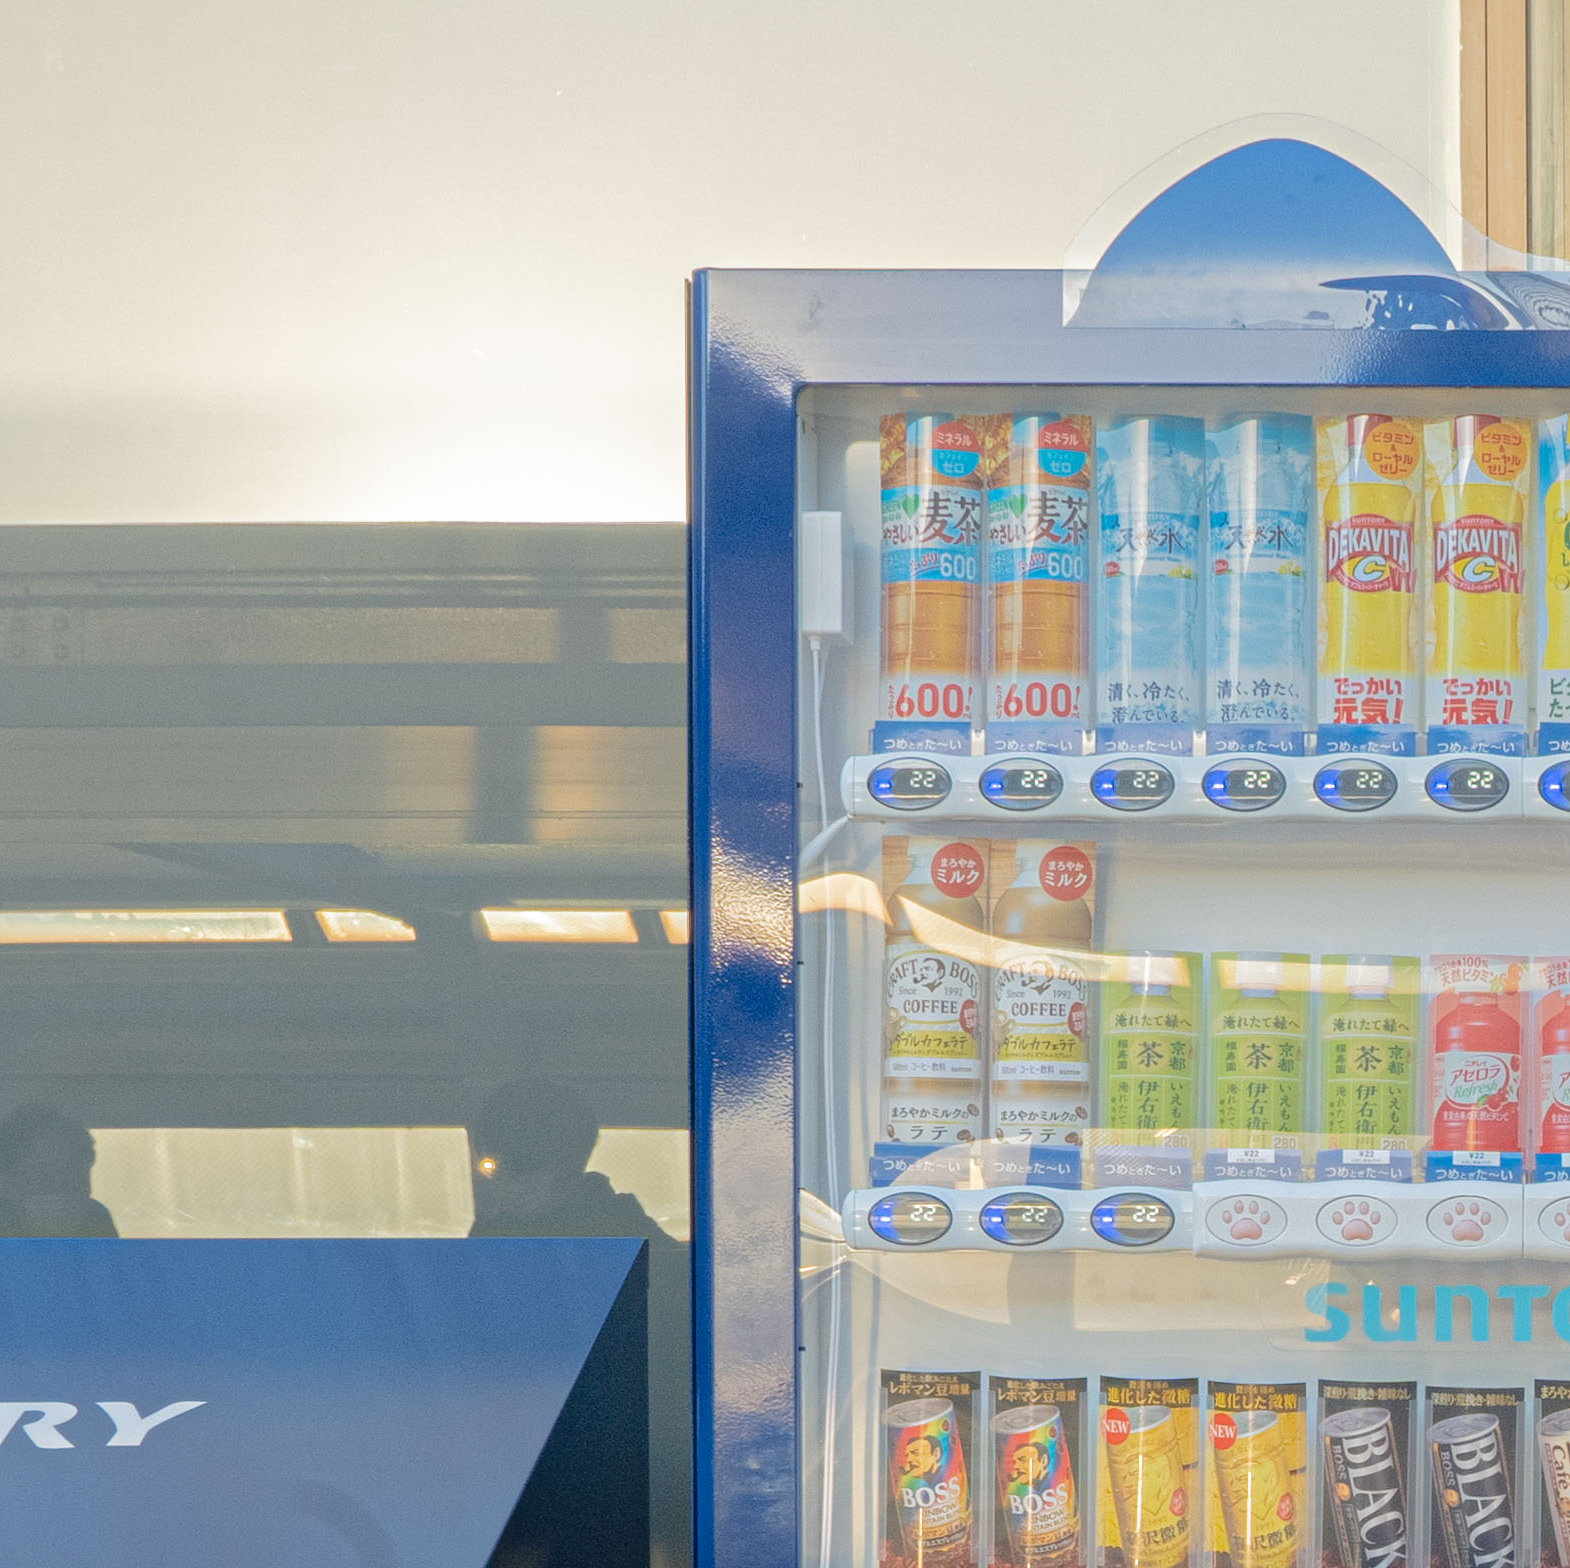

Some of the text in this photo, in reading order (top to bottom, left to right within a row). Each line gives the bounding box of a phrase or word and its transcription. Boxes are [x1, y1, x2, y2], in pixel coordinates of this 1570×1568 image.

[936, 432, 972, 447] ミネラル
[943, 462, 964, 474] ゼロ
[921, 491, 981, 546] 麦茶
[1329, 528, 1409, 573] DEKAVITA
[940, 553, 975, 580] 600
[1353, 556, 1387, 583] C
[1334, 678, 1403, 696] でっかい
[910, 772, 936, 788] 22
[1134, 772, 1159, 788] 22
[1356, 772, 1381, 788] 22
[936, 868, 980, 886] ミルク
[903, 1000, 958, 1014] COFFEE
[1137, 1042, 1164, 1068] 茶
[1451, 1064, 1501, 1086] アセロラ
[1453, 1080, 1498, 1099] Refresh
[1022, 1207, 1046, 1222] 22
[1103, 1419, 1130, 1434] NEW
[902, 1481, 961, 1508] BOSS
